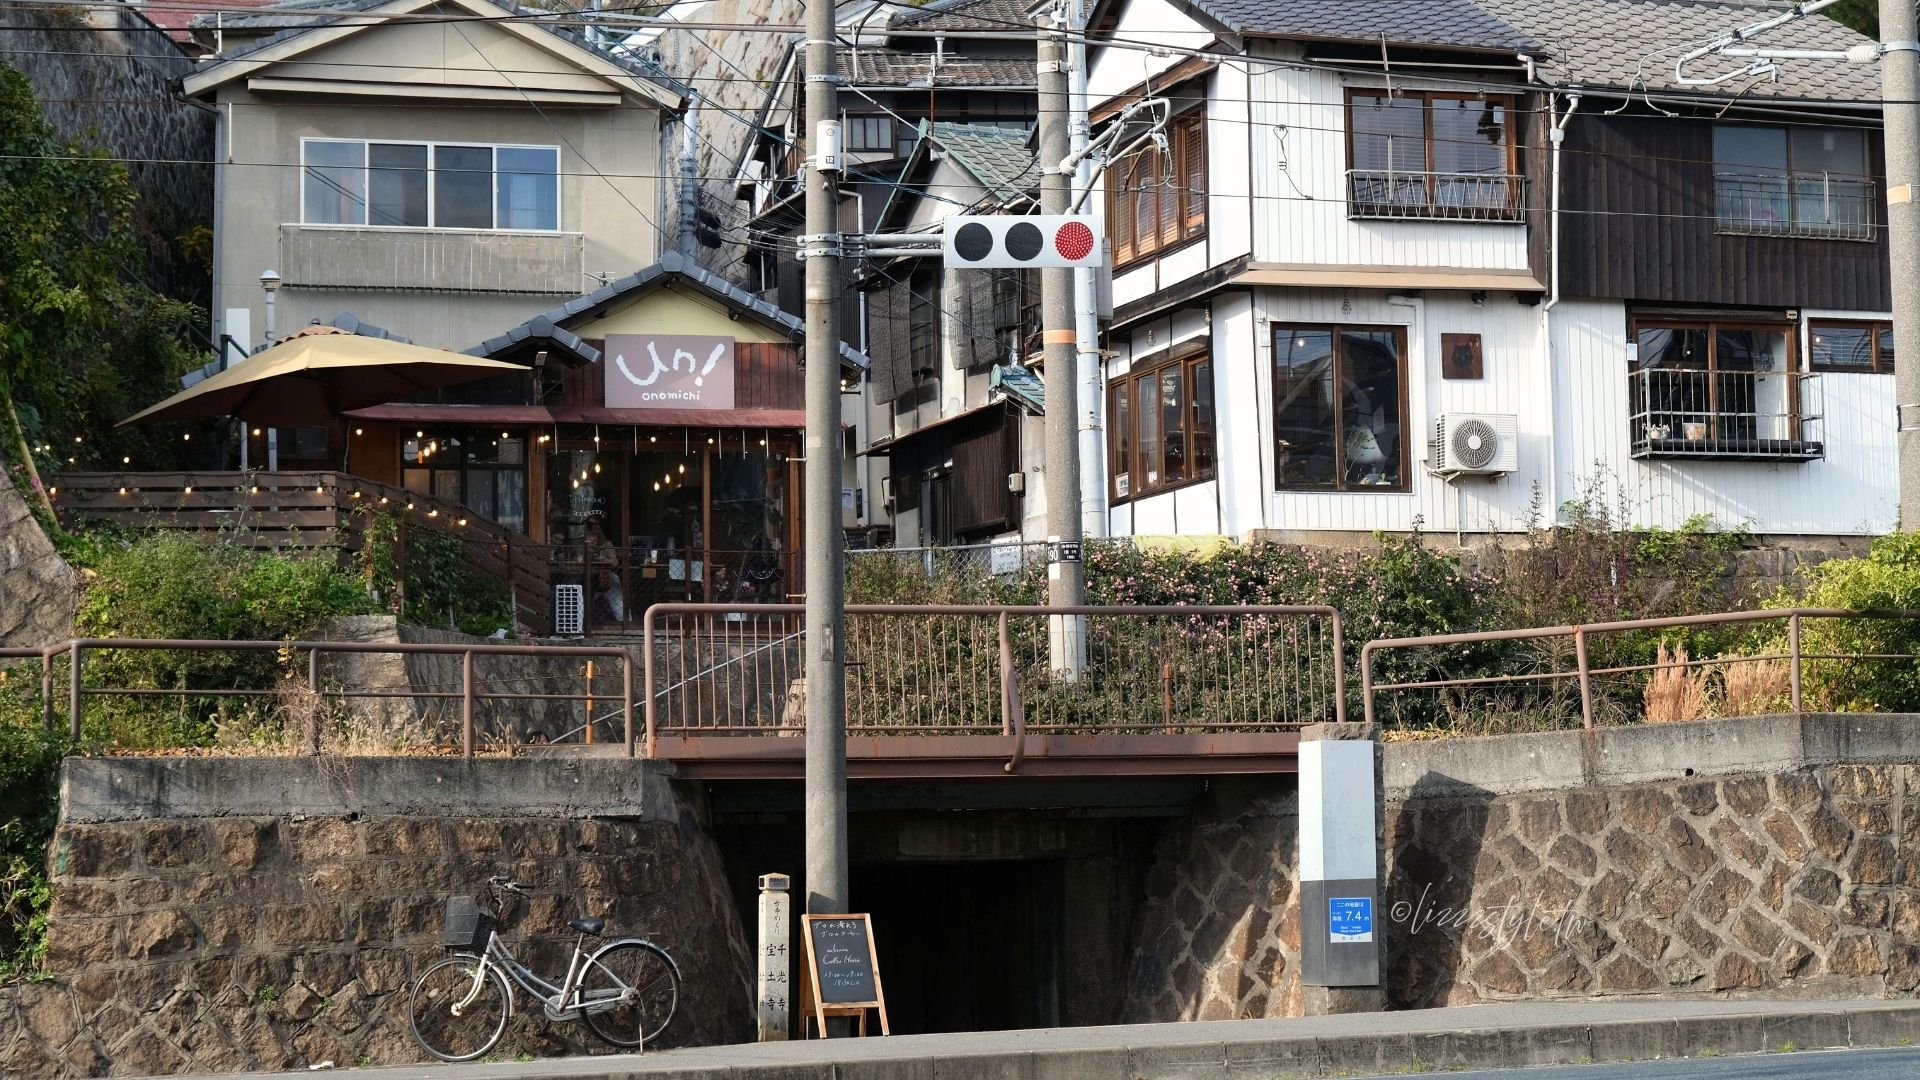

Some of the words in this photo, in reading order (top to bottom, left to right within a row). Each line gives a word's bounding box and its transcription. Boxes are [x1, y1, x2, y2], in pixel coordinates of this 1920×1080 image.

[616, 341, 725, 386] Un!
[641, 390, 700, 400] onomichi
[1345, 911, 1362, 921] 7.4
[777, 944, 786, 1011] 千光寺
